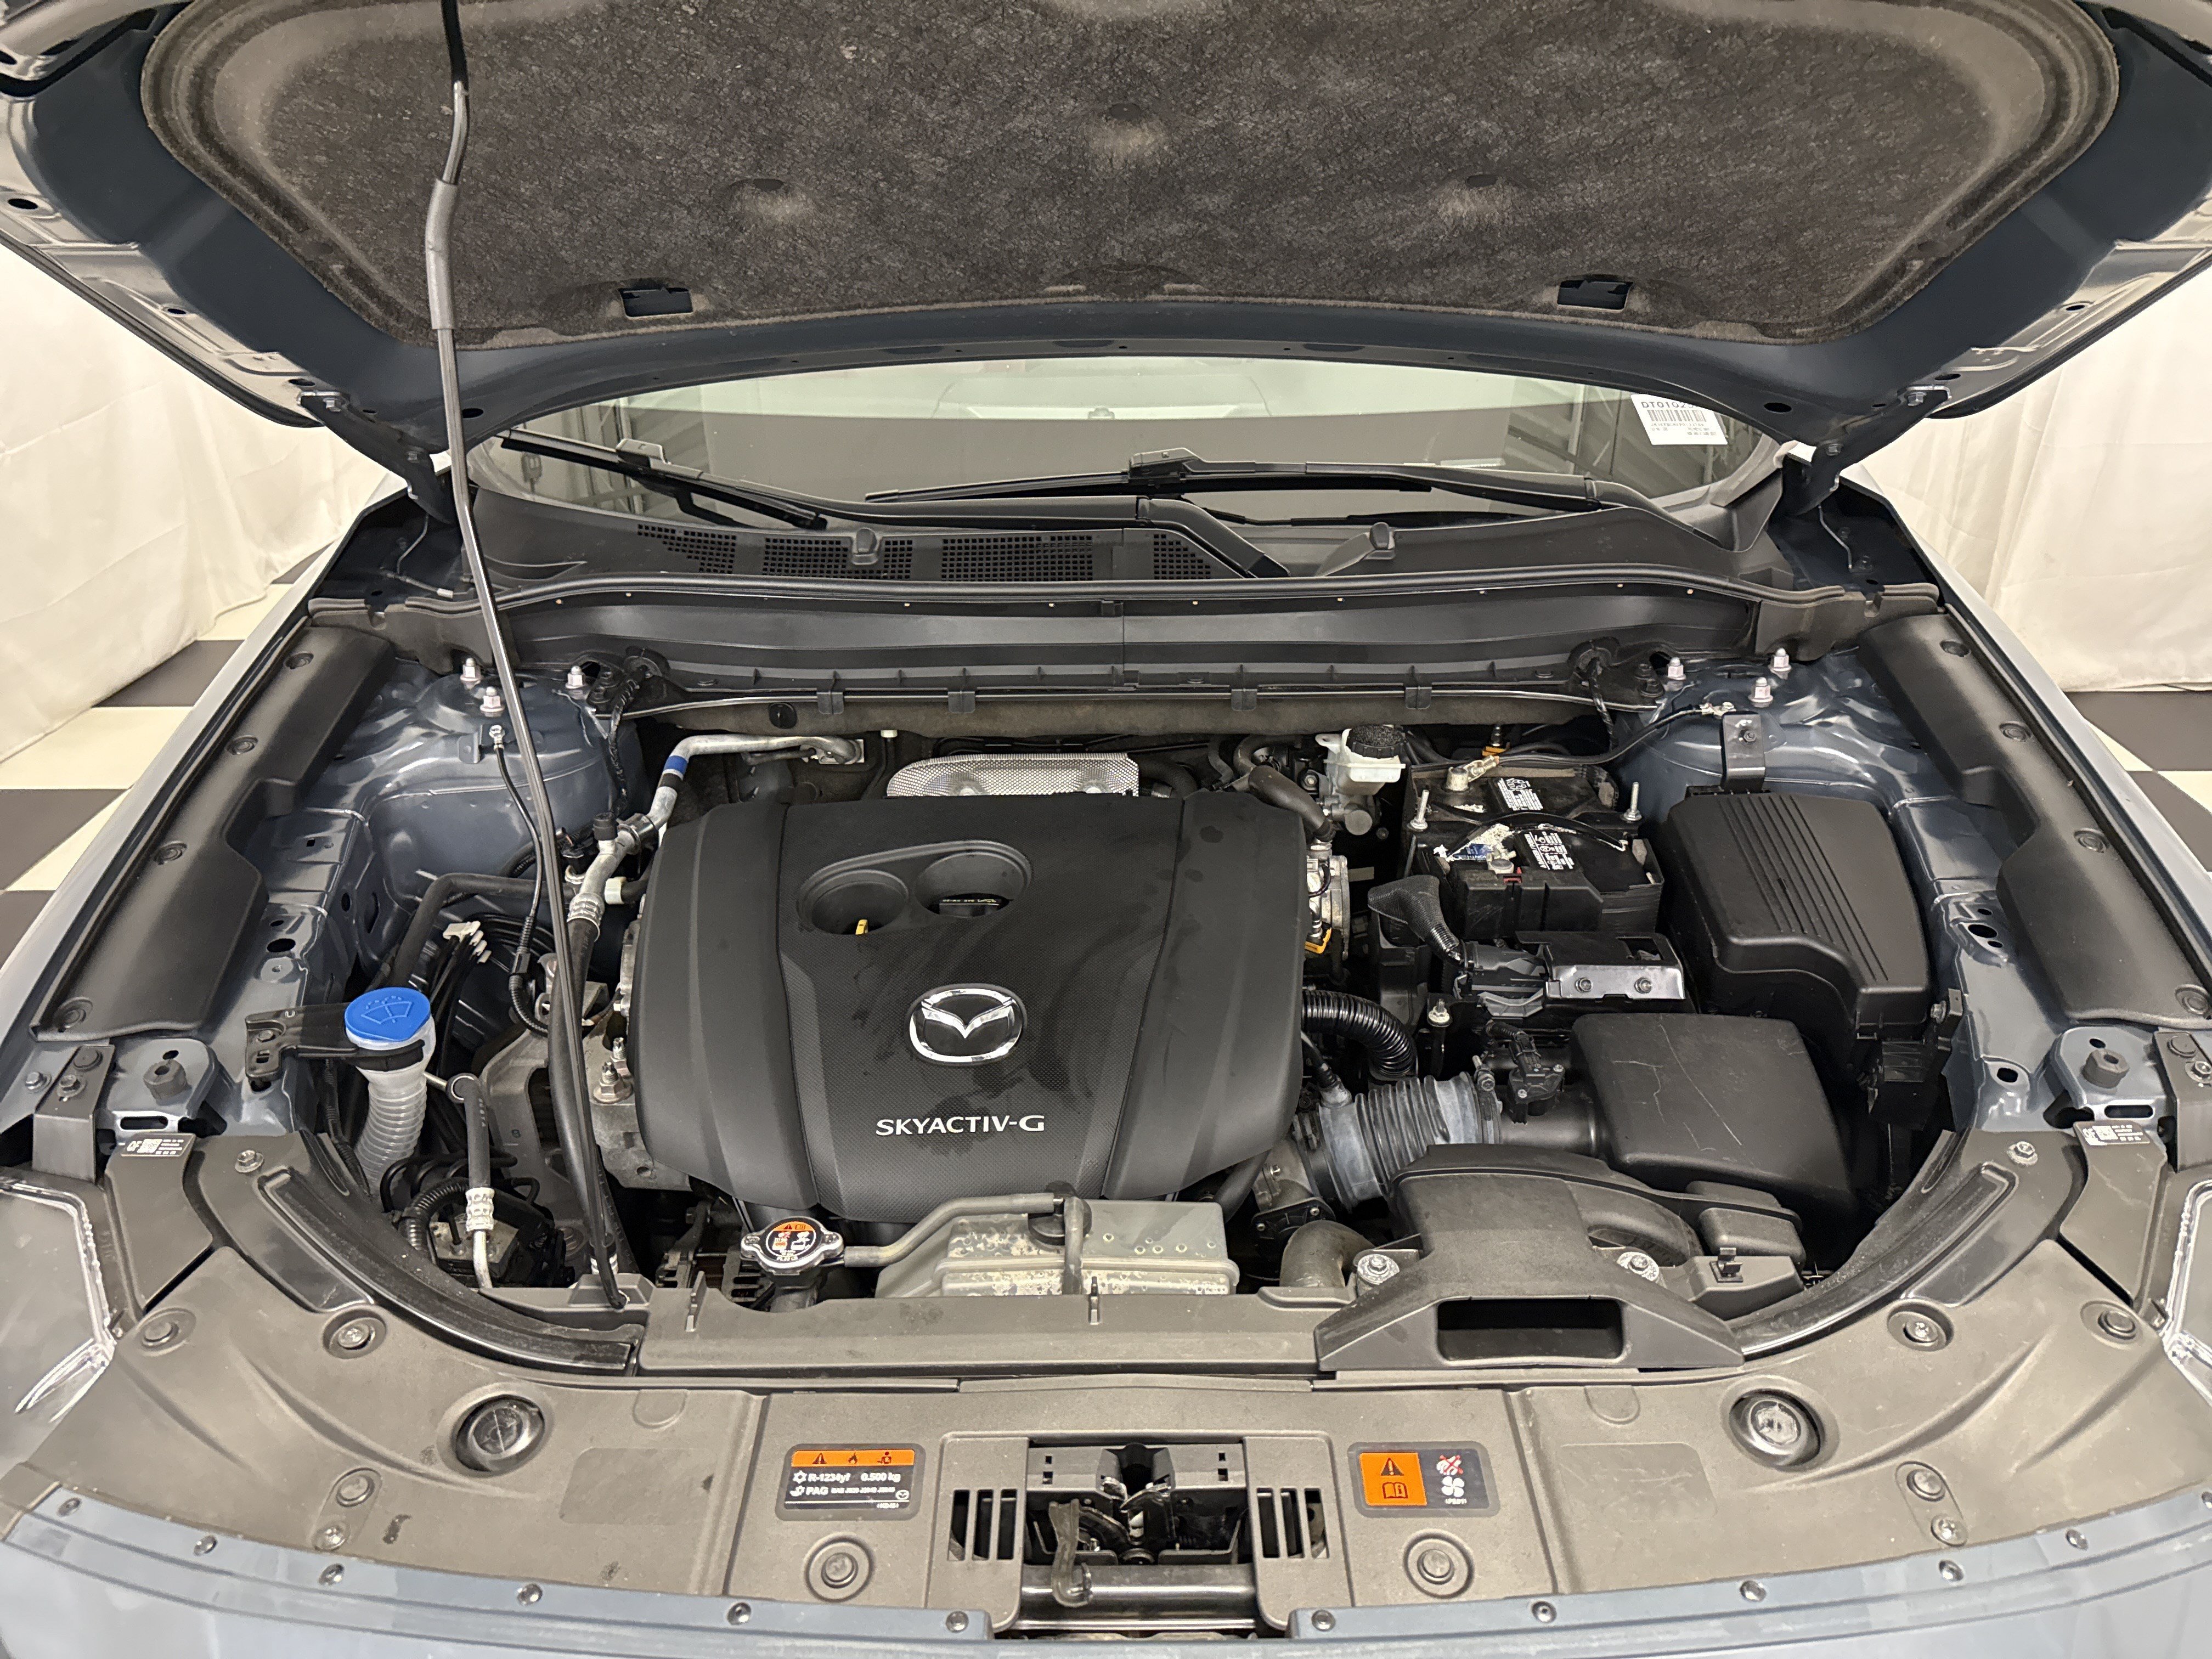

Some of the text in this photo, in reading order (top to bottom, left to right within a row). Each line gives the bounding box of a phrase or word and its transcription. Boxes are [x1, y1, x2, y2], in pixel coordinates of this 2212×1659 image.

[876, 1115, 1045, 1136] SKYACTIV-G
[808, 1472, 901, 1483] R-1234yf 0.500 kg
[806, 1486, 828, 1496] PAG
